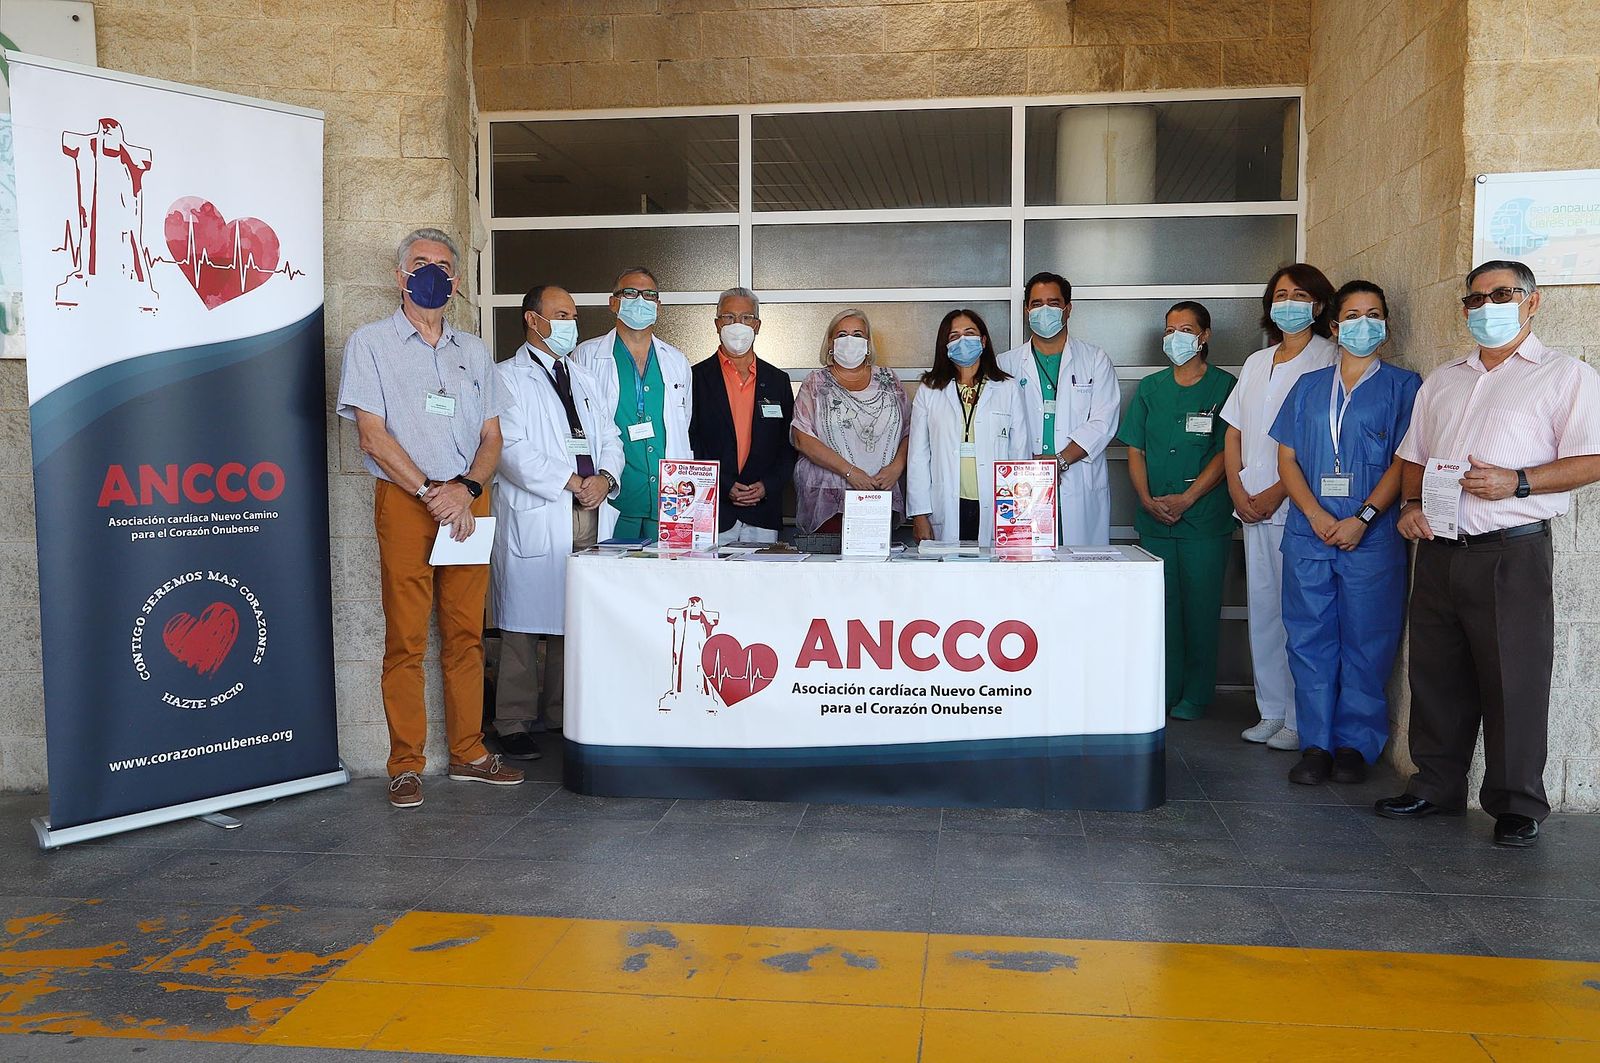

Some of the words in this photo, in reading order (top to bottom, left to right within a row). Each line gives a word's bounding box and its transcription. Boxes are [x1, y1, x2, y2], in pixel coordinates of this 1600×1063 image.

[97, 461, 285, 507] ANCCO
[108, 515, 166, 527] Asociación
[167, 513, 209, 524] cardíaca
[211, 512, 242, 522] Nuevo
[243, 510, 279, 520] Camino
[131, 530, 156, 542] para
[157, 528, 167, 538] el
[169, 526, 210, 537] Corazón
[212, 524, 260, 535] Onubense
[132, 616, 151, 681] CONTIGO
[142, 571, 203, 615] SEREMOS
[207, 570, 239, 588] MAS
[239, 586, 267, 665] CORAZONES
[794, 618, 1038, 672] ANCCO
[161, 692, 207, 709] HAZTE
[210, 682, 244, 707] SOCIO
[791, 682, 866, 696] Asociación
[869, 683, 927, 697] cardíaca
[930, 684, 976, 697] Nuevo
[979, 685, 1032, 697] Camino
[820, 703, 852, 716] para
[854, 702, 867, 714] el
[870, 702, 928, 715] Corazón
[931, 702, 1003, 715] Onubense
[109, 729, 293, 772] www.corazononubense.org
